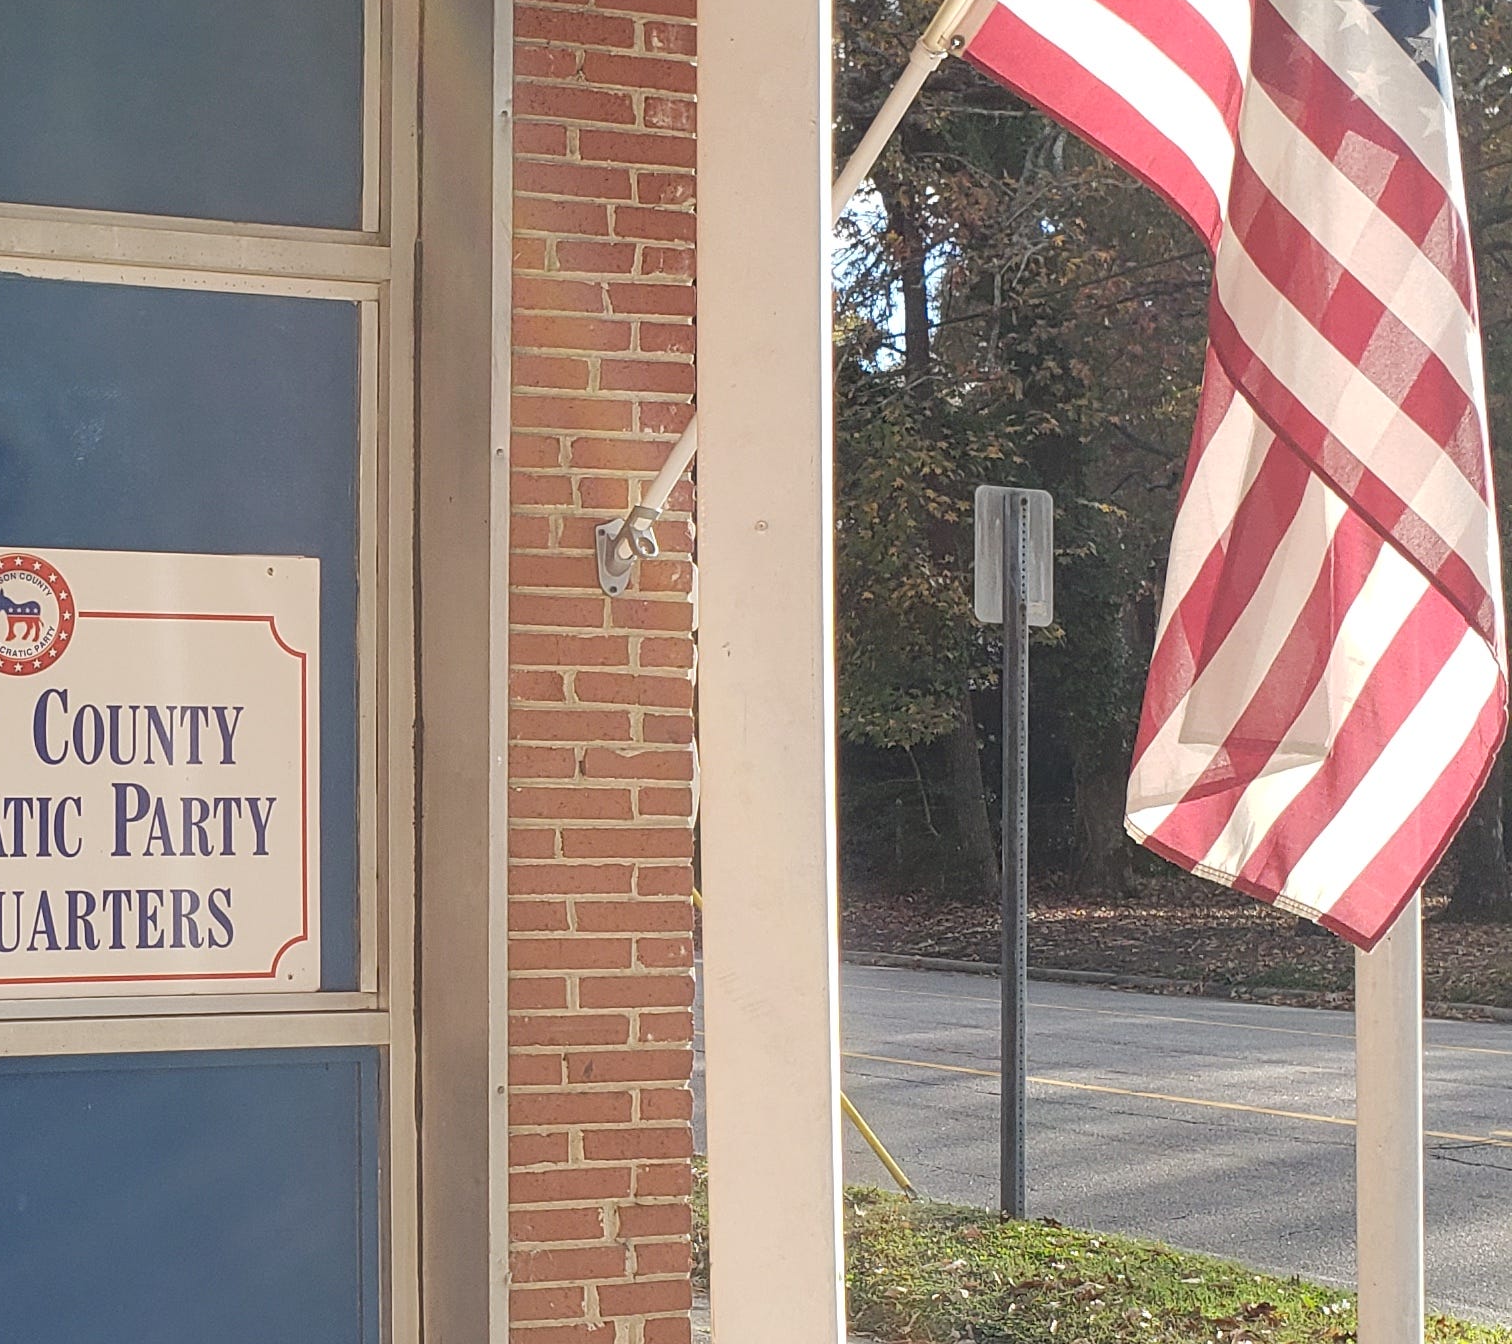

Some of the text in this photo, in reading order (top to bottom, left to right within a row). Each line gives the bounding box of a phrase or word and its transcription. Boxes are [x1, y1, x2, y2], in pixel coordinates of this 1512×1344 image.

[19, 573, 52, 596] COUNTY
[34, 626, 55, 652] PARTY
[33, 688, 244, 765] COUNTY
[111, 782, 277, 857] PARTY
